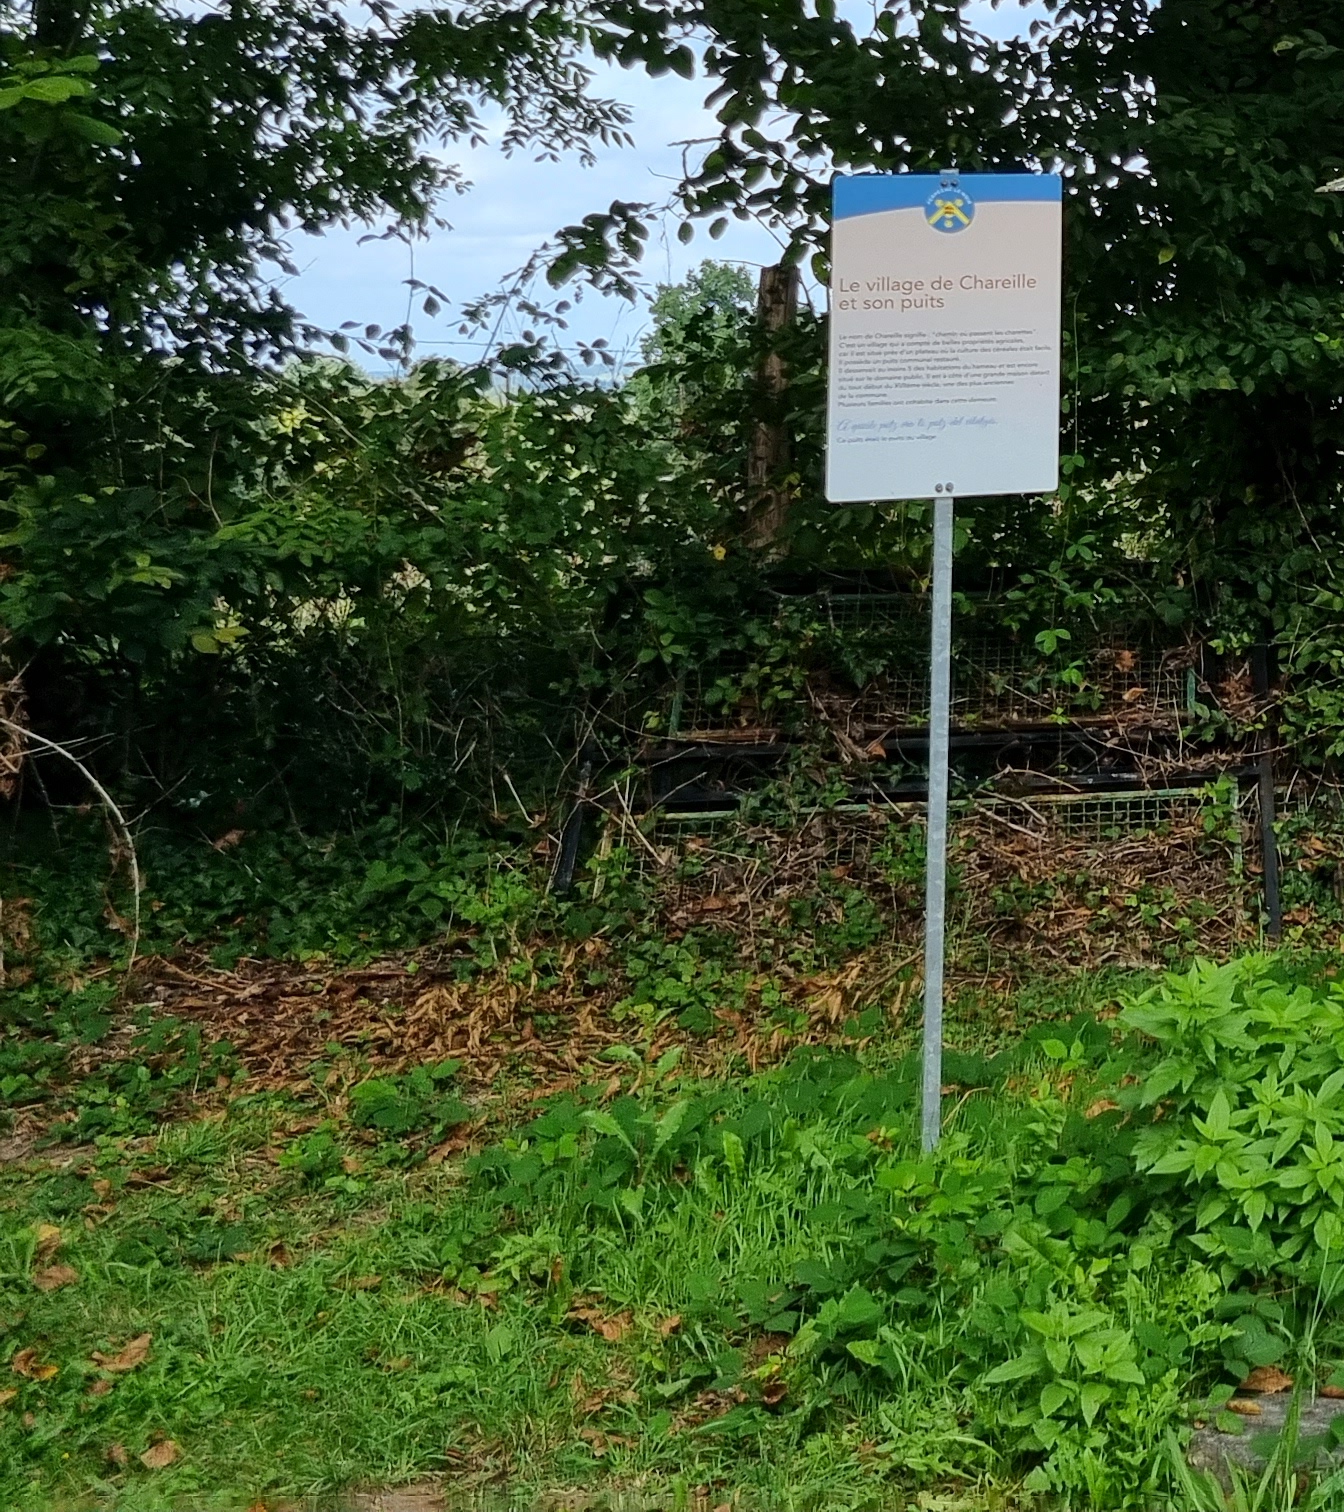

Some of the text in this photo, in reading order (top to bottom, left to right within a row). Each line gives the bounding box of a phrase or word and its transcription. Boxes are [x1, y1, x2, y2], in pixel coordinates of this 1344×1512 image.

[839, 274, 1037, 296] Le village de Chareille
[839, 294, 945, 313] et son puits
